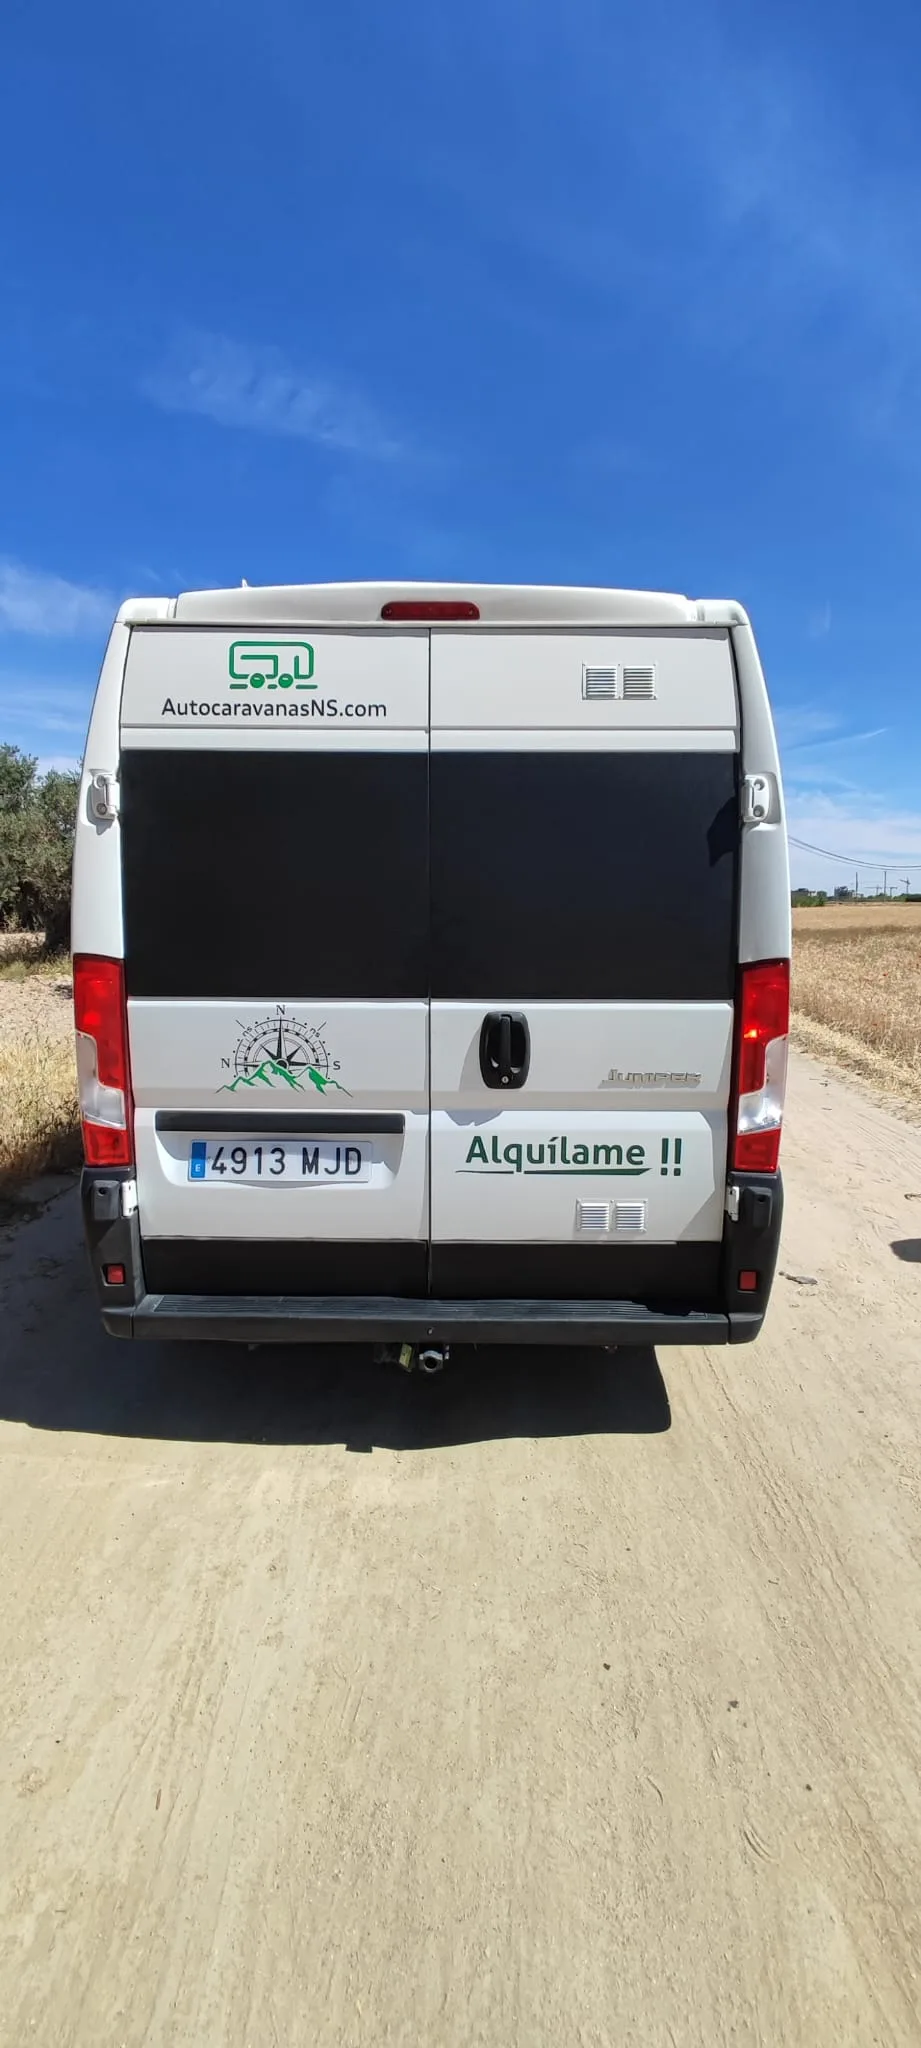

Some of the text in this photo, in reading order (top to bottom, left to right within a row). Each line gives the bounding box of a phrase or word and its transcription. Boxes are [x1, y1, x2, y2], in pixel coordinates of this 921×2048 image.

[161, 698, 387, 717] AutocaravanasNS.com
[276, 1004, 286, 1015] N
[220, 1057, 231, 1068] N
[332, 1060, 341, 1070] S
[211, 1146, 363, 1176] 4913 MJD
[465, 1135, 646, 1173] Alquílame
